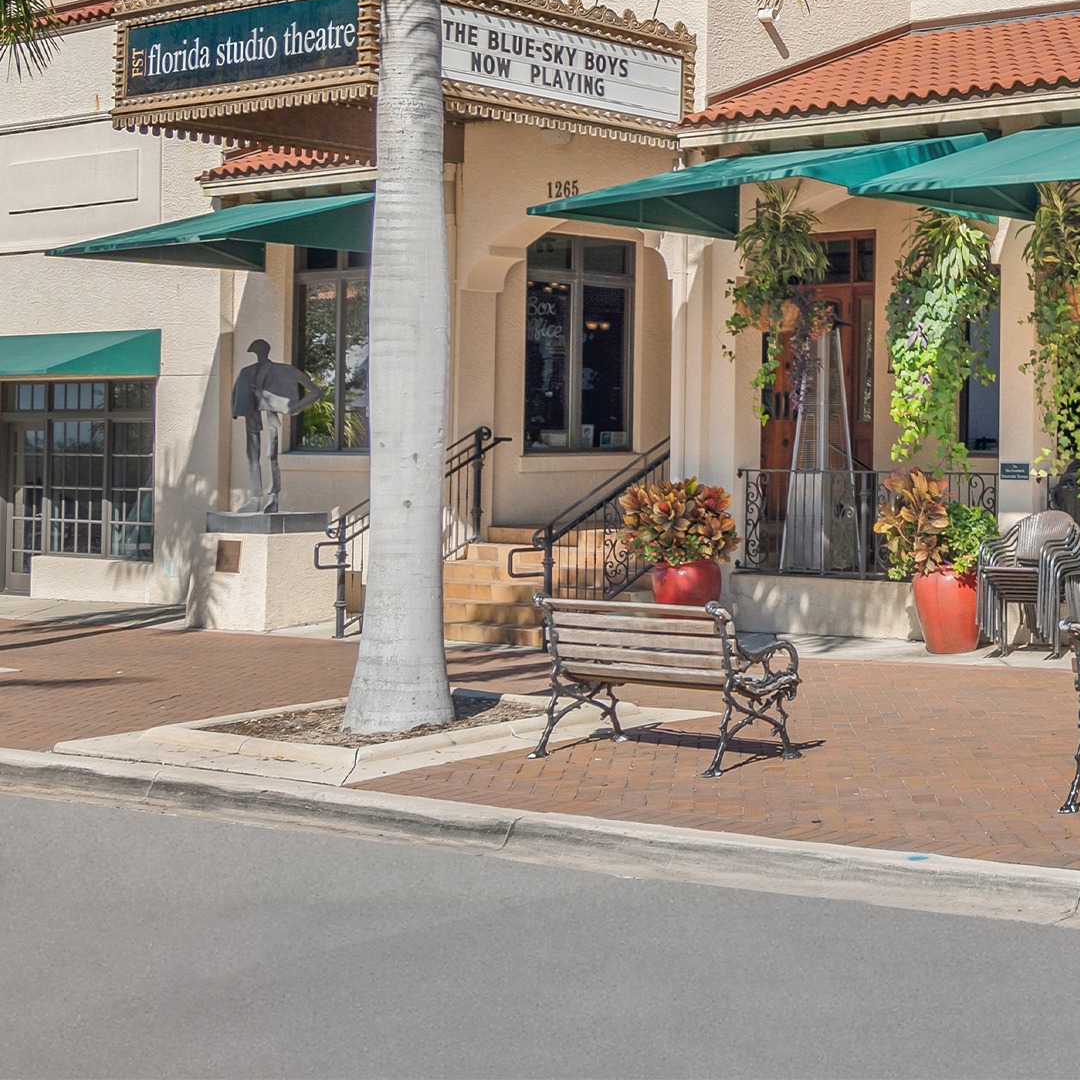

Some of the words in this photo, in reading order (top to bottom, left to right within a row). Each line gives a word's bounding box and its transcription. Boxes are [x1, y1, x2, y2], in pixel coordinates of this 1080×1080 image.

[131, 47, 145, 78] FST
[147, 37, 211, 77] florida
[216, 26, 277, 67] studio
[283, 20, 356, 56] theatre
[442, 19, 478, 46] THE
[488, 30, 578, 67] BLUE-SKY
[584, 51, 629, 78] BOYS
[471, 51, 511, 78] NOW
[530, 64, 605, 97] PLAYING
[546, 180, 579, 198] 1265
[527, 296, 556, 316] Box
[526, 317, 563, 340] ffice
